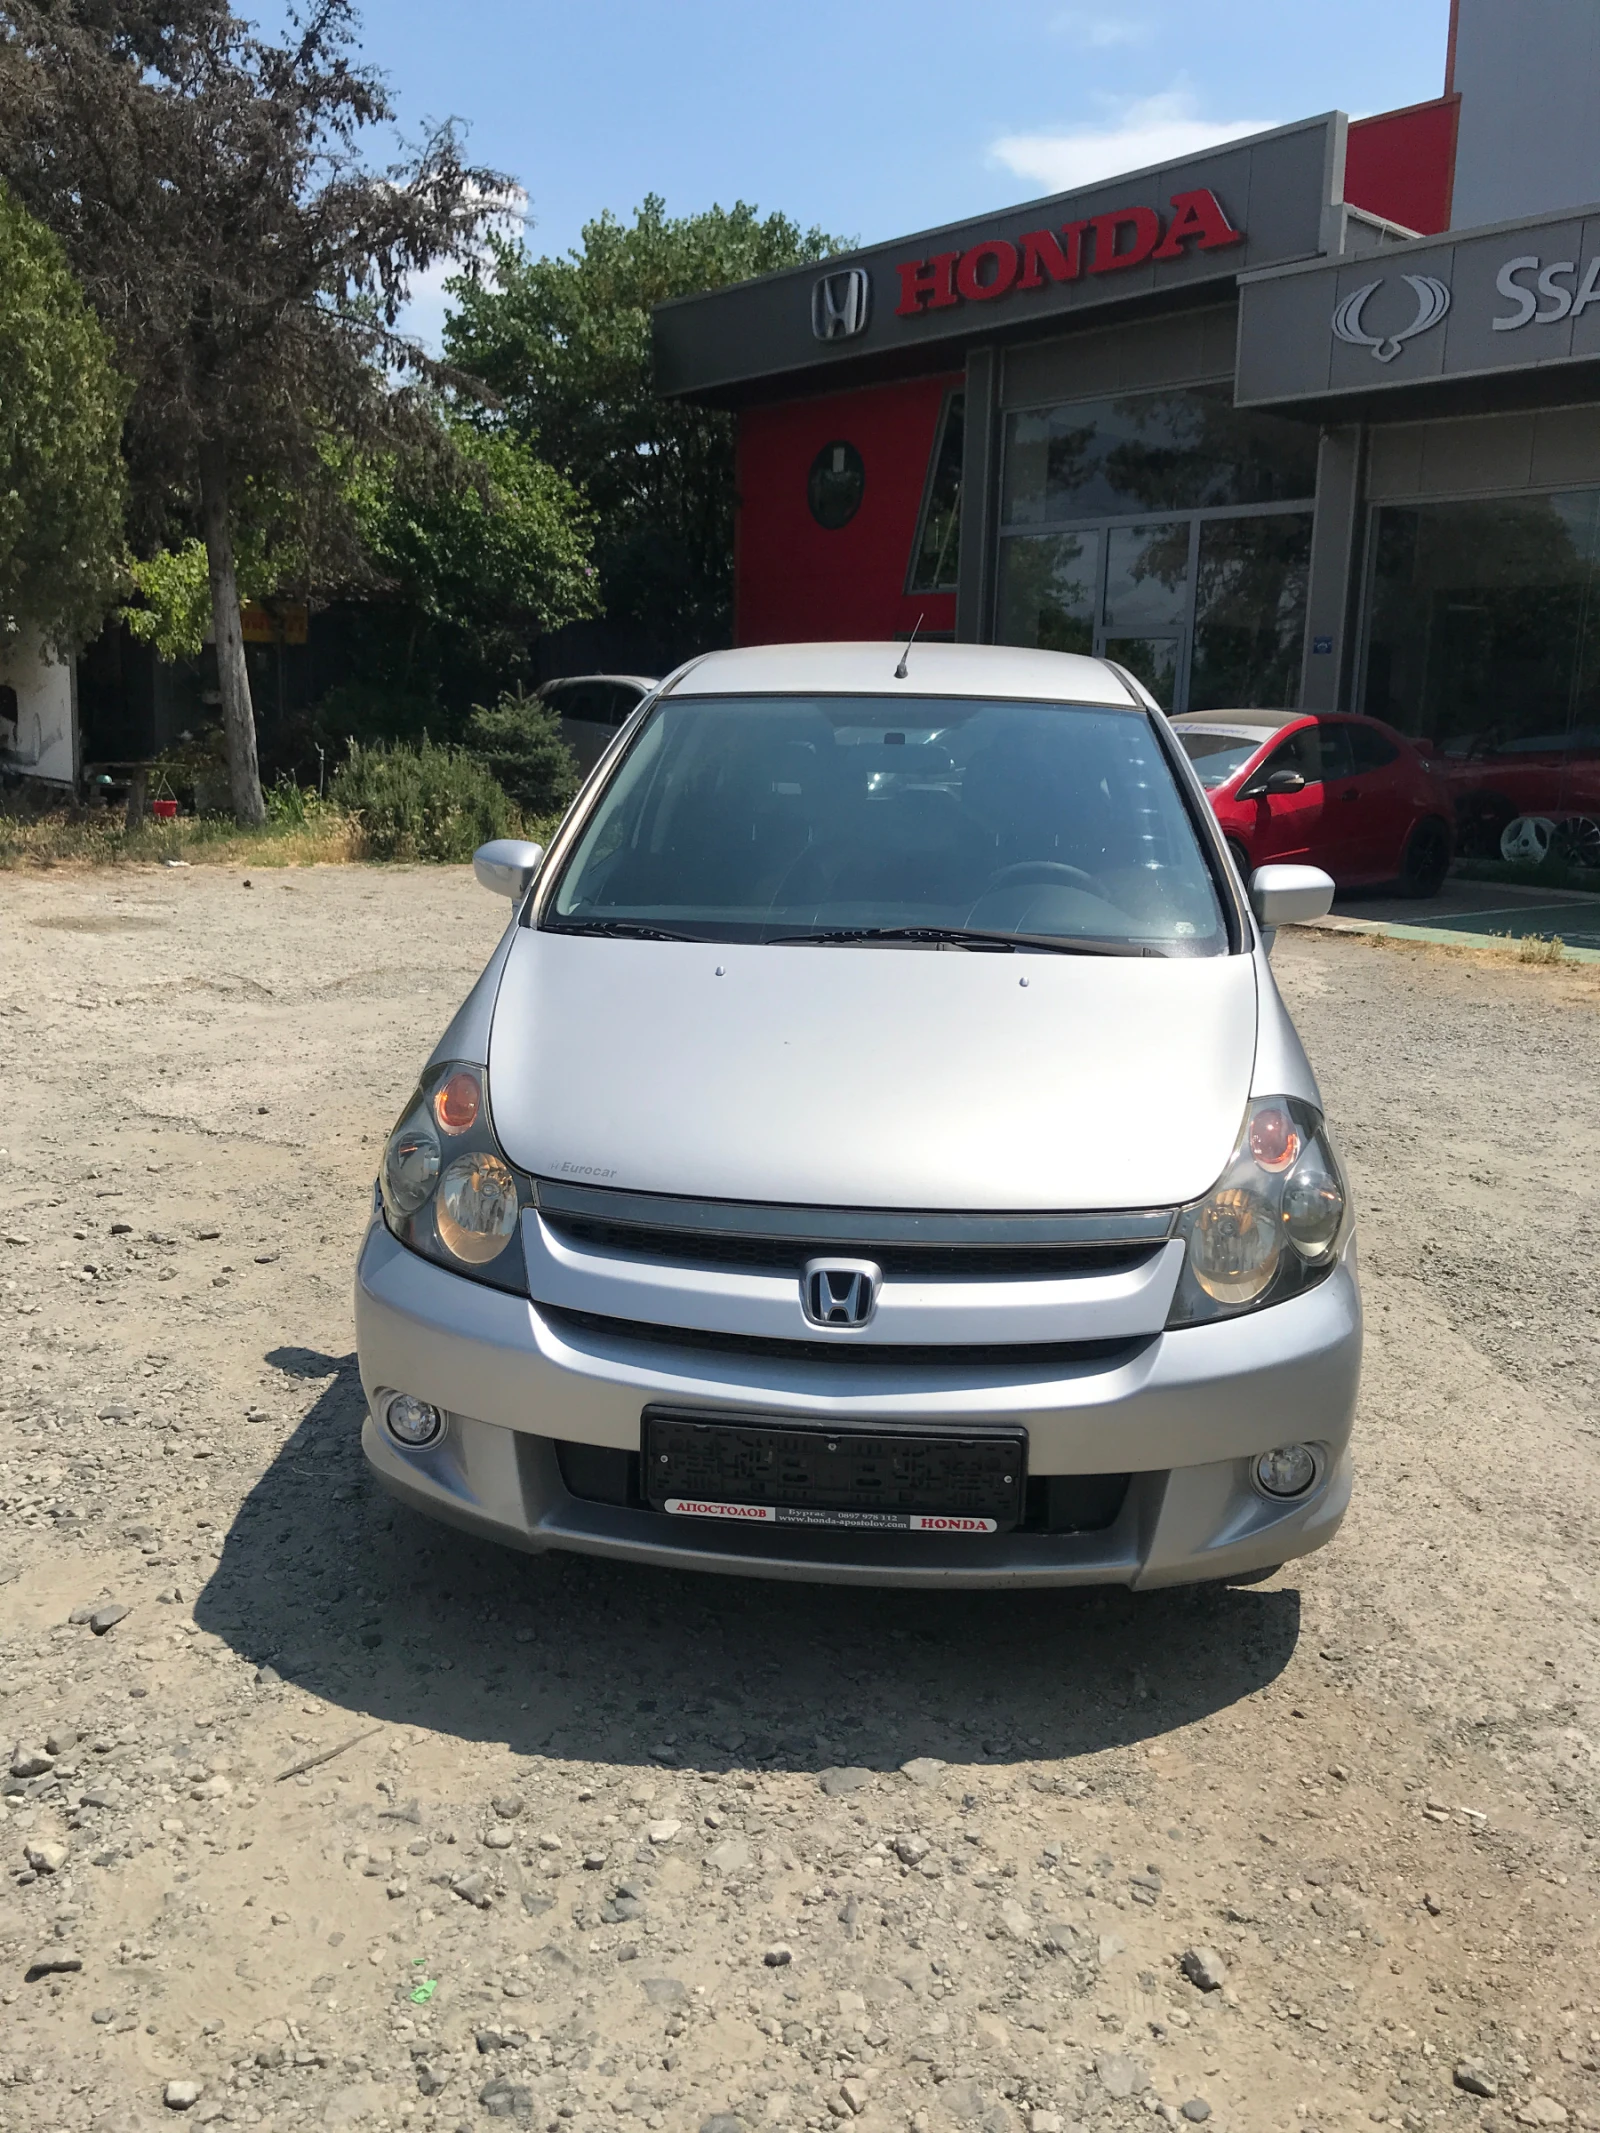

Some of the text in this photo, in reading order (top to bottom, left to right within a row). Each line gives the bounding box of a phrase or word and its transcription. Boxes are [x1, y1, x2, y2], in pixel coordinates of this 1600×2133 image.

[894, 188, 1240, 315] HONDA
[560, 1161, 617, 1178] Eurocar
[676, 1502, 767, 1518] АПОСТОЛОВ
[778, 1515, 908, 1529] www.honda-apostolov.com
[881, 1514, 898, 1522] 112
[920, 1518, 988, 1531] HONDA
